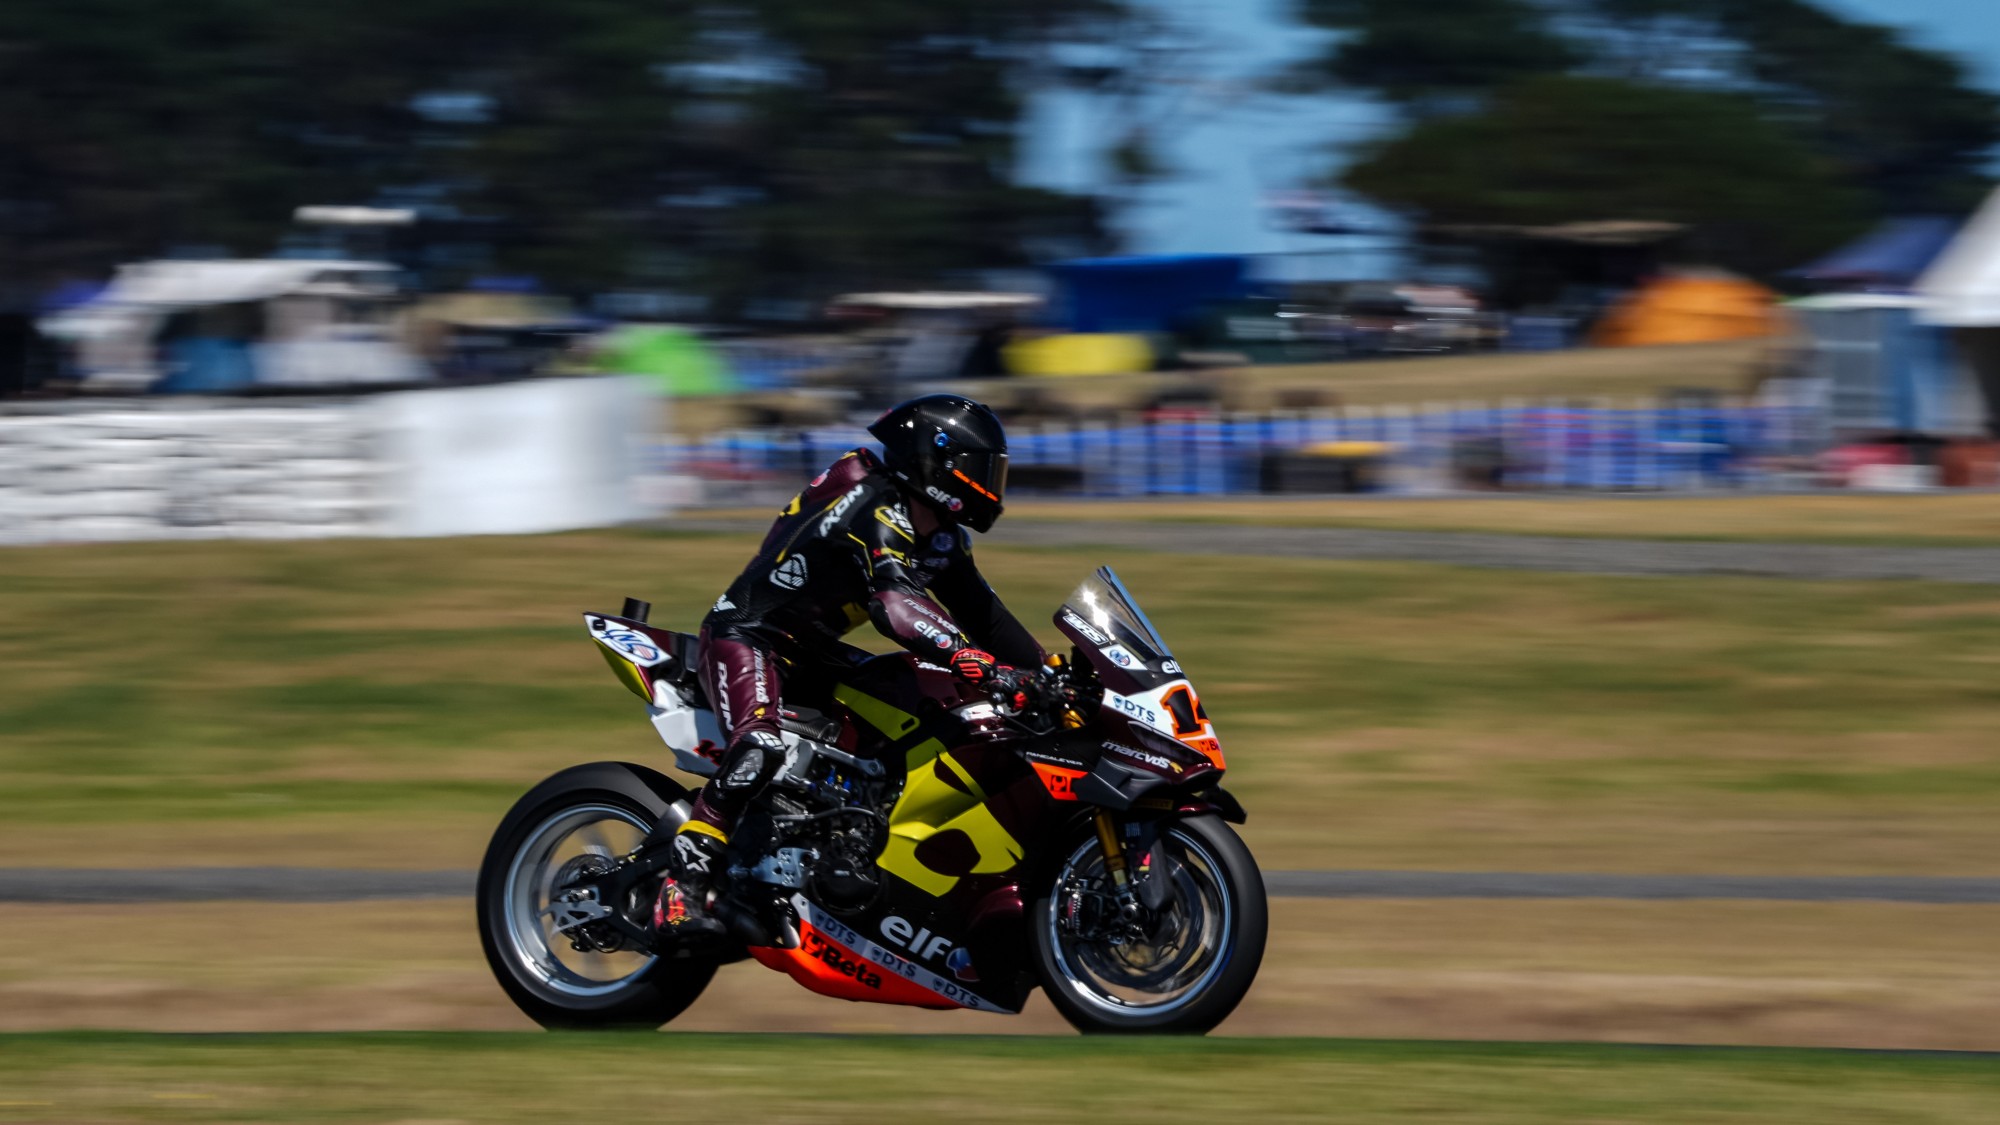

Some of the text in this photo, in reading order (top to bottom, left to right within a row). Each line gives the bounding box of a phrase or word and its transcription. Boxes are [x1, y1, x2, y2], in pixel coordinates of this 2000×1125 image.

[926, 486, 949, 505] elf
[913, 620, 942, 639] elf
[1124, 699, 1156, 723] DTS
[1160, 685, 1210, 738] 1
[824, 917, 857, 945] DTS
[880, 915, 953, 962] elf
[822, 945, 883, 991] Beta
[881, 951, 917, 978] DTS
[943, 982, 980, 1008] DTS
